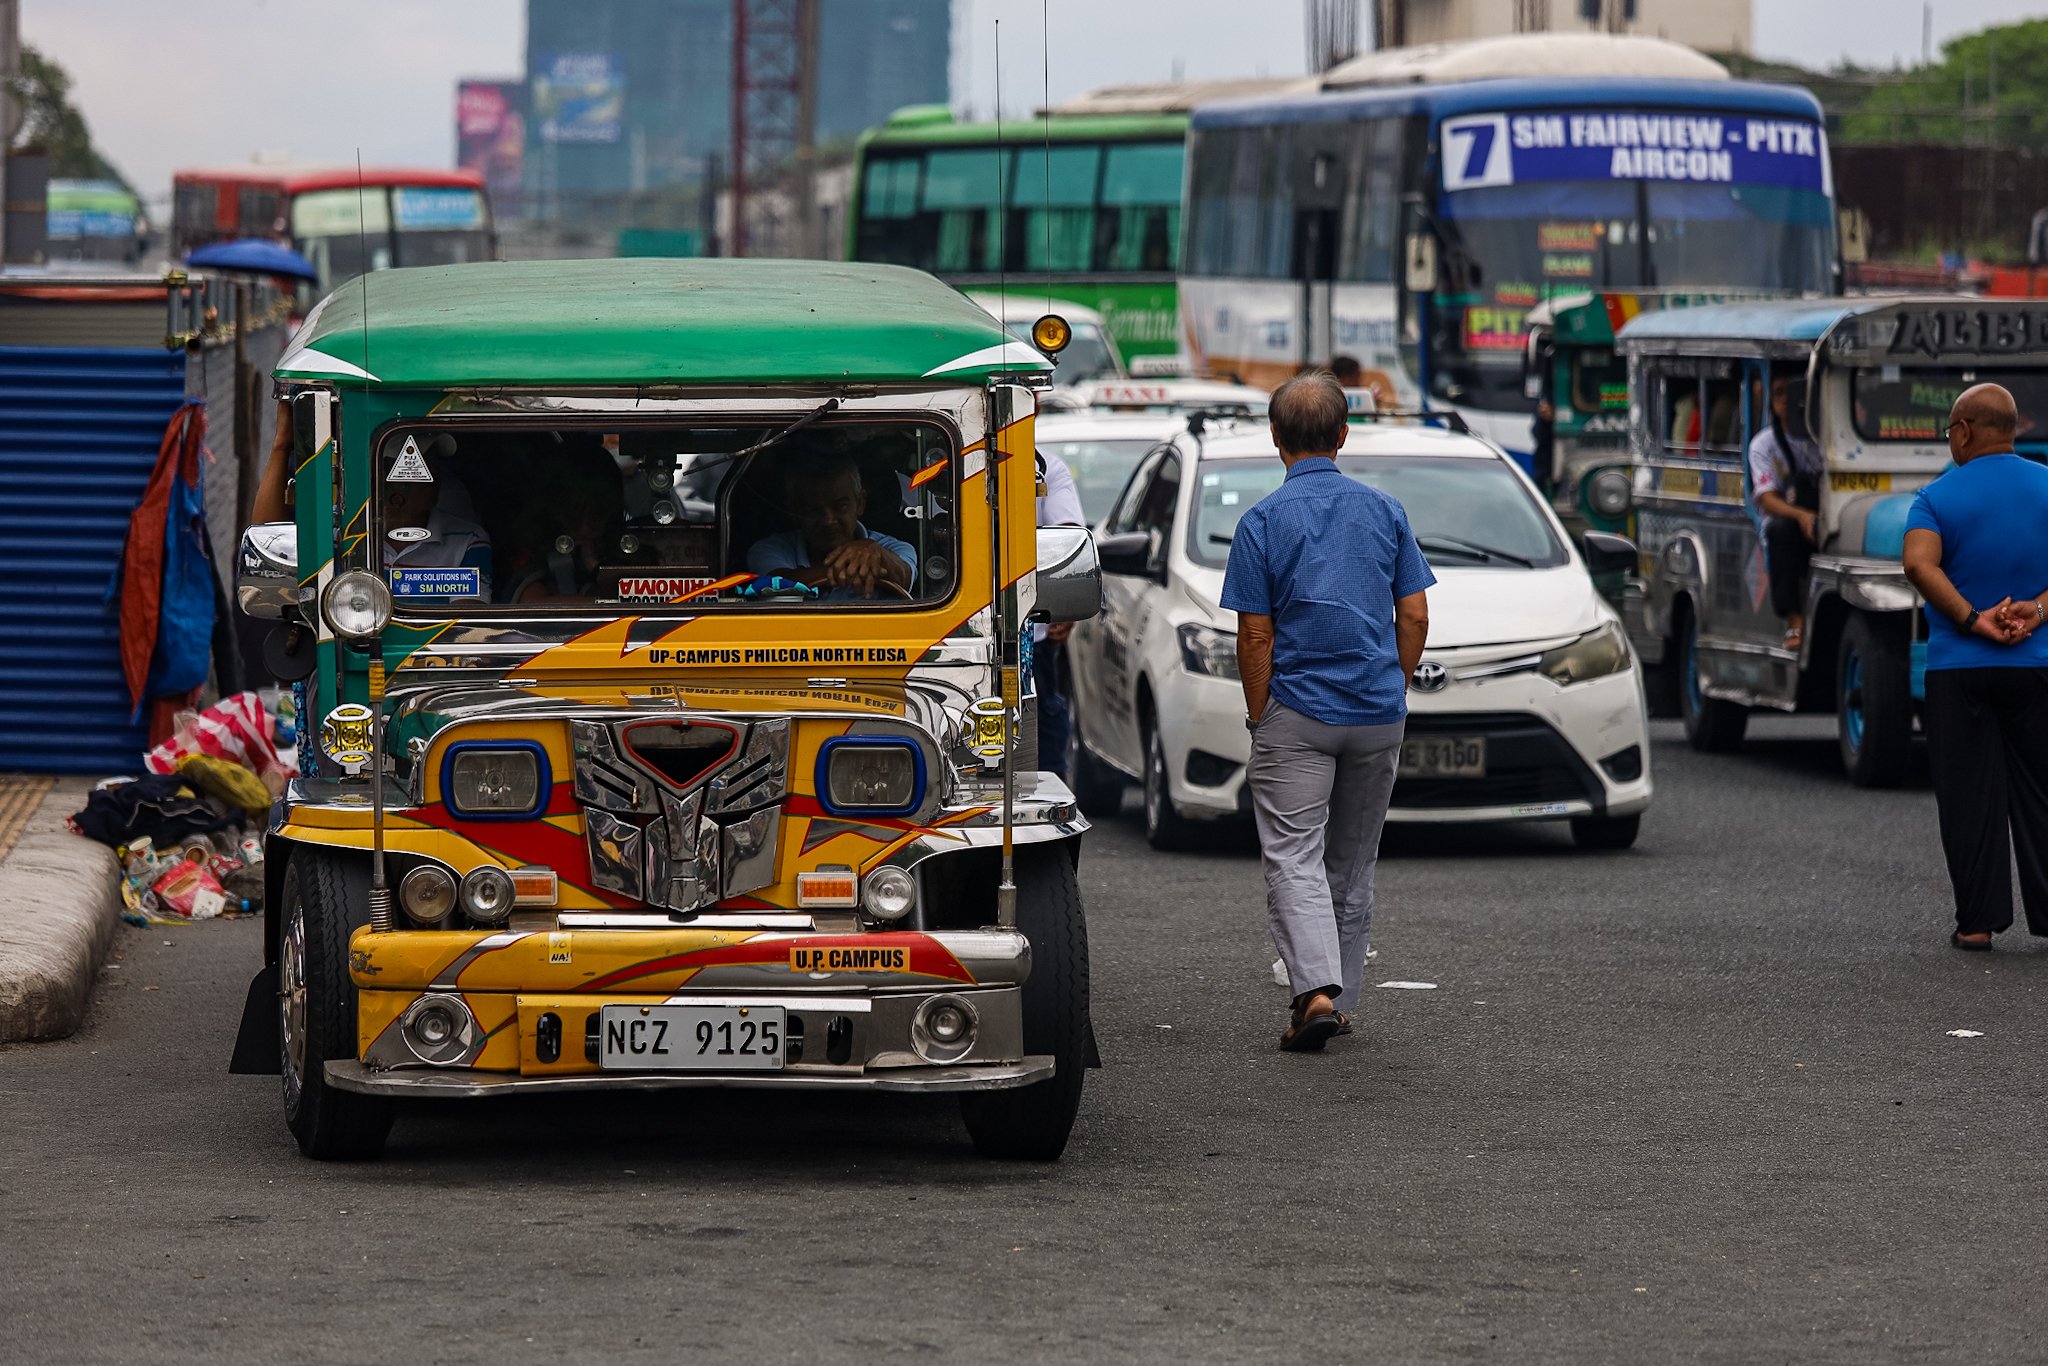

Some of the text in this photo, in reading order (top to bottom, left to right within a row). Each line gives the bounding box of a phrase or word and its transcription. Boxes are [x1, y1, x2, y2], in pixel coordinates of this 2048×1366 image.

[1512, 118, 1566, 148] SM
[1570, 115, 1723, 149] FAIRVIEW
[1746, 120, 1815, 157] PITX
[1450, 121, 1499, 181] 7
[1610, 147, 1732, 182] AIRCON
[1103, 386, 1167, 401] TAXI
[404, 573, 474, 581] PARK SOLUTIONS INC.
[419, 584, 470, 593] SM NORTH
[650, 647, 907, 664] UP-CAMPUS PHILCOA NORTH EDSA
[795, 949, 904, 970] U.P. CAMPUS
[607, 1019, 779, 1056] NCZ 9125
